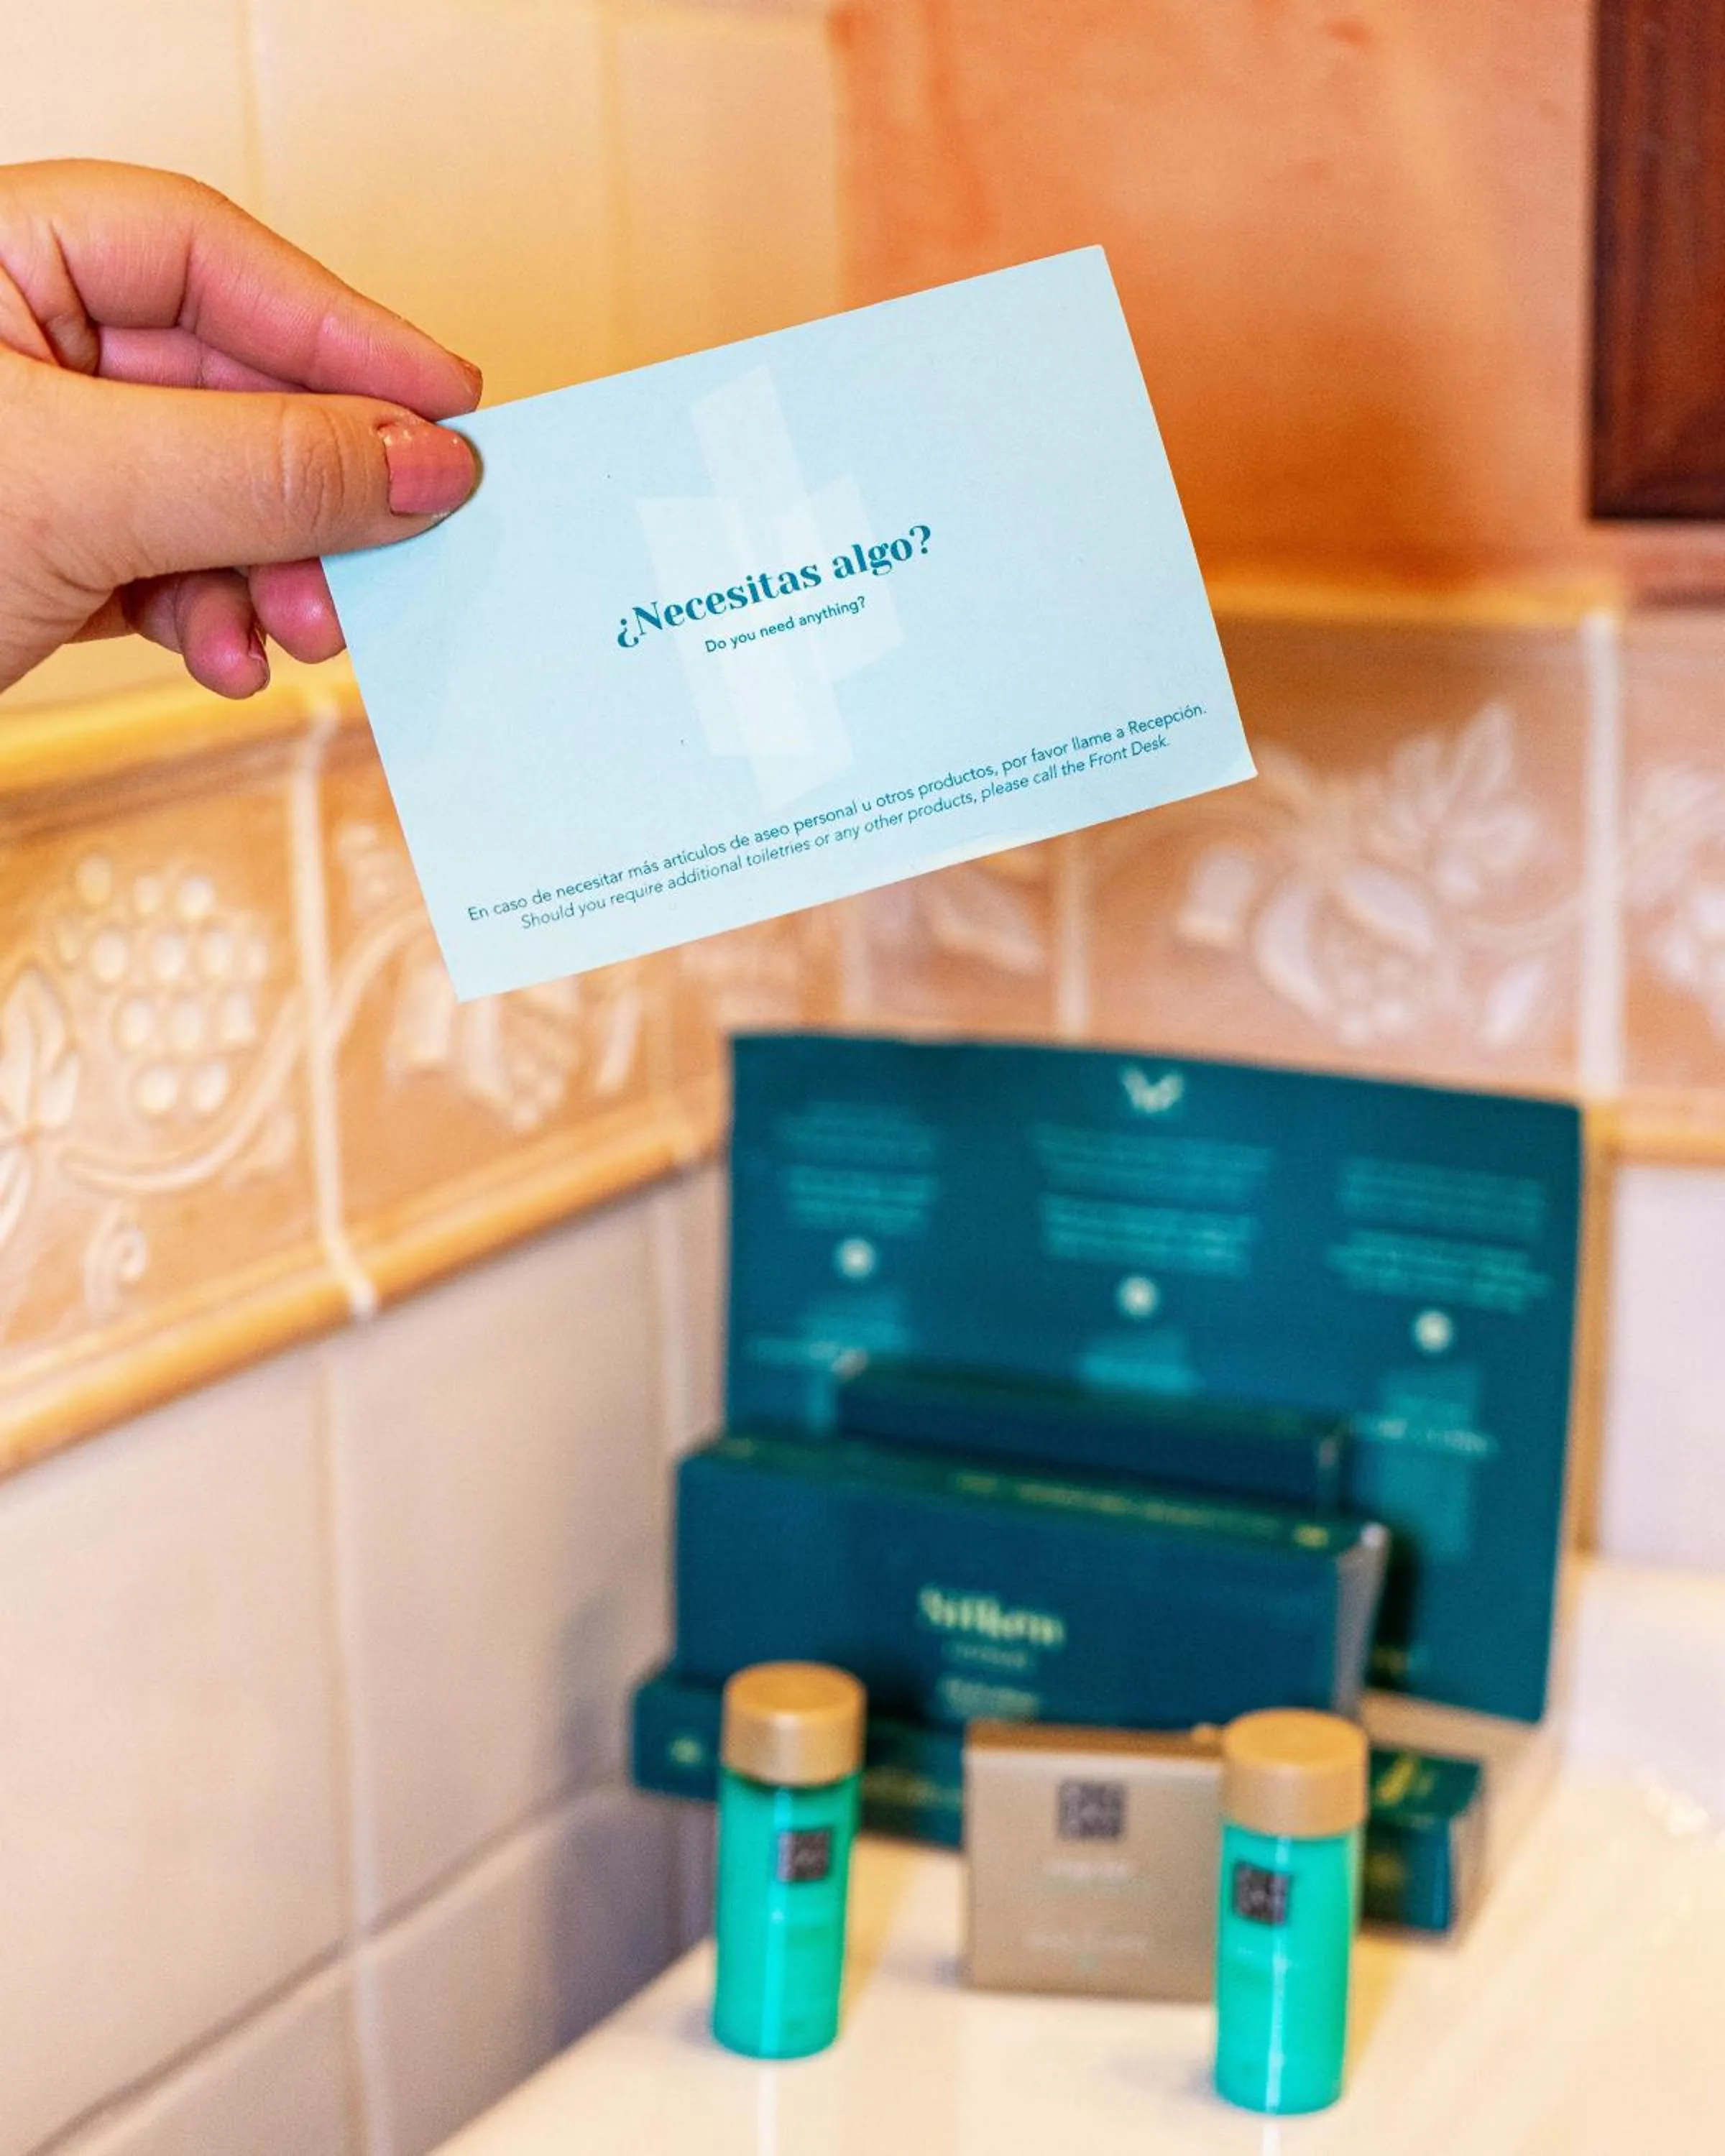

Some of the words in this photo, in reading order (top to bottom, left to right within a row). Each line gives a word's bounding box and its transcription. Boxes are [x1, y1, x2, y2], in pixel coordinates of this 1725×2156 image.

[615, 563, 823, 649] ¿Necesitas
[831, 523, 932, 580] algo?
[704, 637, 727, 653] Do
[729, 631, 757, 650] you
[758, 614, 796, 638] need
[798, 594, 865, 627] anything?
[466, 906, 489, 921] En
[492, 897, 528, 915] caso
[530, 888, 552, 905] de
[555, 870, 623, 898] necesitar
[627, 859, 660, 879] más
[729, 833, 750, 850] de
[753, 824, 790, 843] aseo
[792, 799, 858, 836] personal
[860, 800, 872, 812] u
[875, 788, 915, 808] otros
[916, 765, 998, 800] productos,
[1000, 754, 1028, 776] por
[1029, 742, 1069, 763] favor
[1070, 730, 1113, 751] llame
[1115, 727, 1126, 739] a
[1126, 704, 1207, 735] Recepción.
[520, 901, 575, 929] Should
[577, 898, 606, 918] you
[609, 882, 663, 905] require
[667, 854, 742, 890] additional
[745, 839, 811, 867] toiletries
[813, 833, 830, 848] or
[834, 825, 860, 842] any
[863, 811, 903, 833] other
[906, 792, 978, 824] products,
[980, 776, 1029, 803] please
[1031, 763, 1058, 785] call
[1059, 759, 1086, 777] the
[1087, 746, 1128, 768] Front
